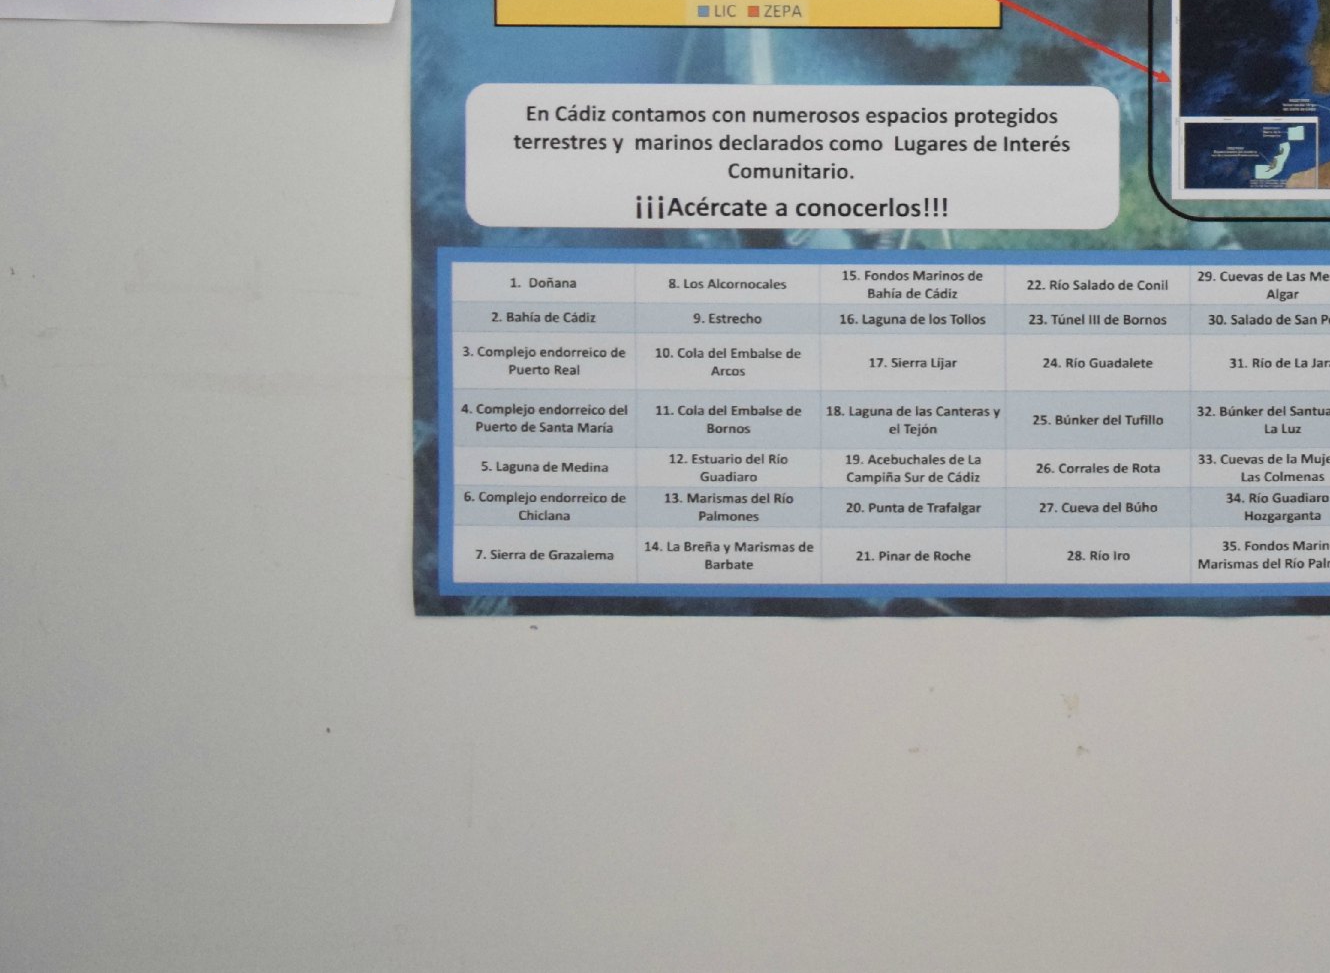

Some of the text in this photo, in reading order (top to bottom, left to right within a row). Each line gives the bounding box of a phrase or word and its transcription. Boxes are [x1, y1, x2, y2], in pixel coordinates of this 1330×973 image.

[715, 5, 736, 18] LIC
[764, 5, 802, 18] ZEPA
[527, 105, 1058, 128] En Cádiz contamos con numerosos espacios protegidos
[514, 135, 1070, 156] terrestres y marinos declarados como Lugares de Interés
[728, 163, 854, 179] Comunitario.
[776, 203, 787, 217] a
[796, 198, 947, 217] conocerlos!!!
[511, 278, 577, 288] 1. Doñana
[693, 313, 762, 324] 9. Estrecho
[1043, 358, 1153, 368] 24. Río Guadalete
